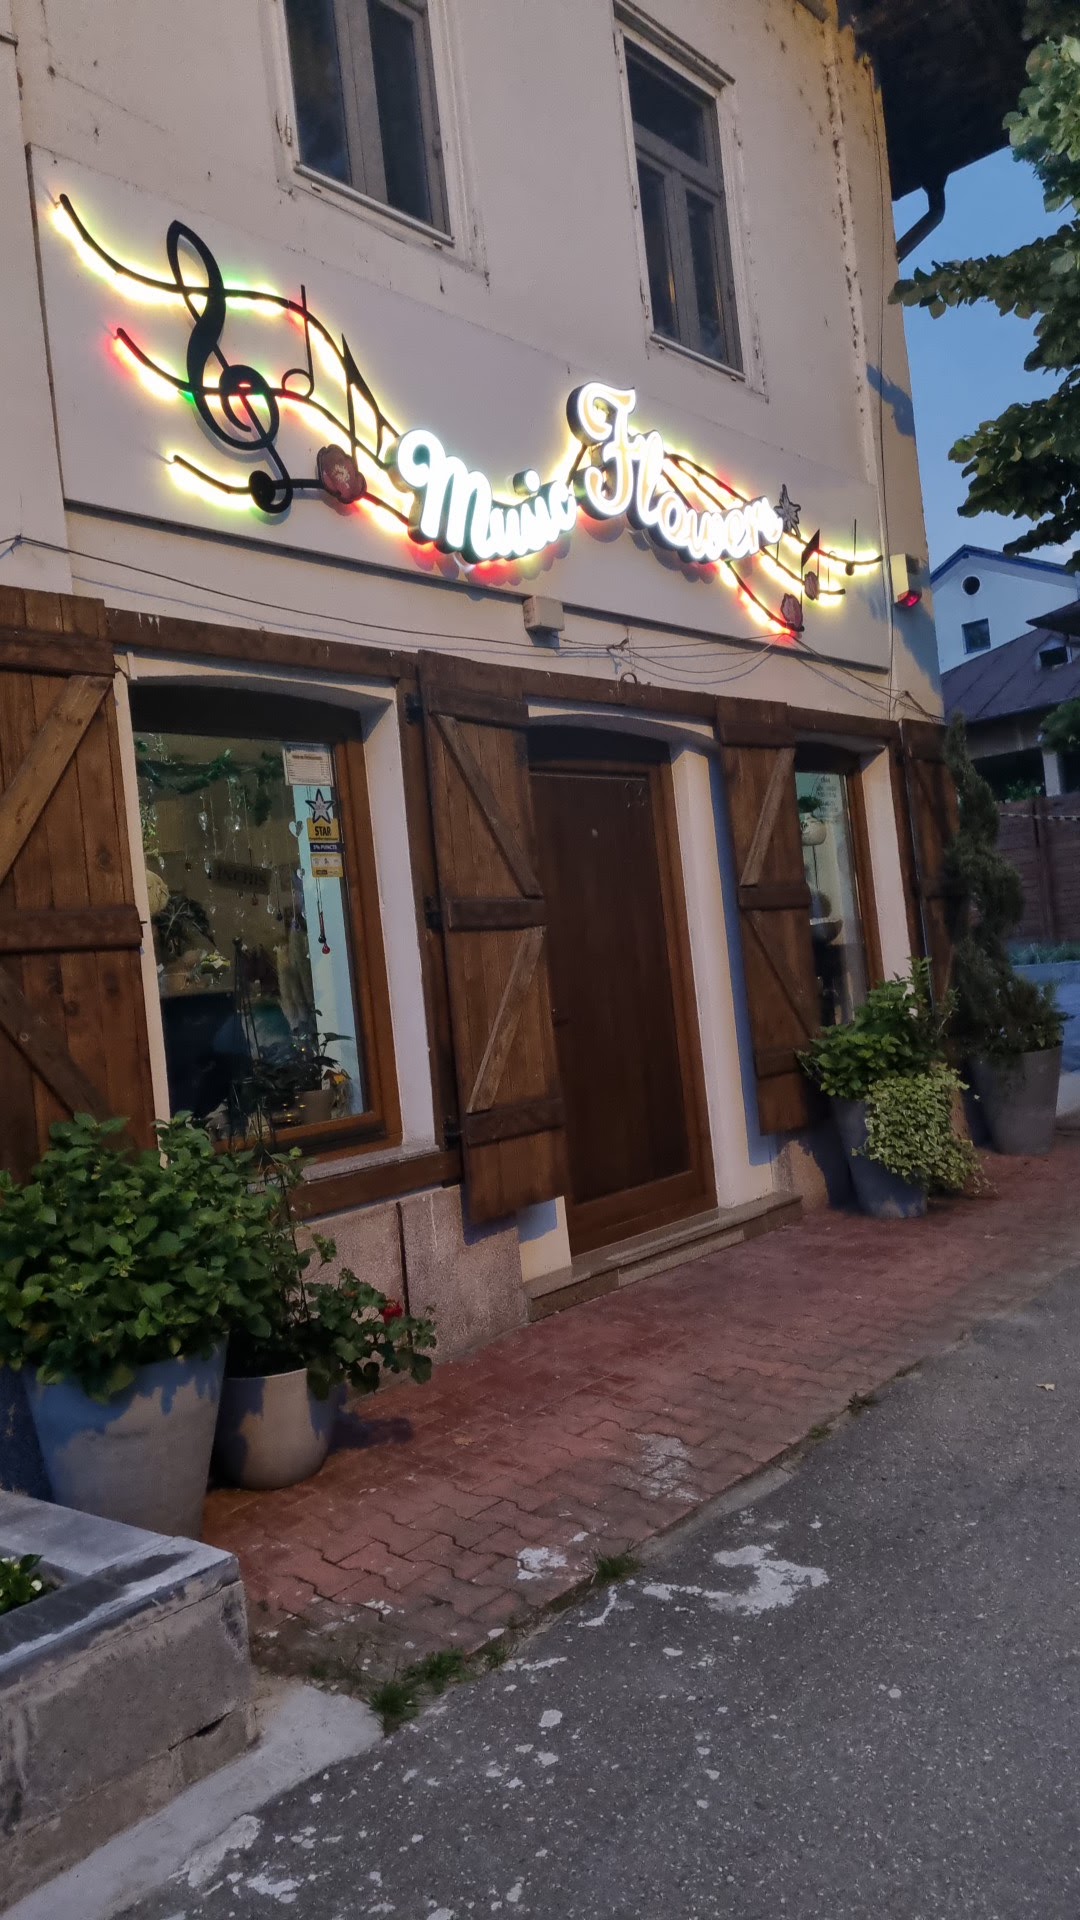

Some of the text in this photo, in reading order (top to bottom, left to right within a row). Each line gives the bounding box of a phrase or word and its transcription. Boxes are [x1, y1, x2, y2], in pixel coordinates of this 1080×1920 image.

[397, 381, 784, 562] Music Flower
[314, 826, 332, 836] STAR
